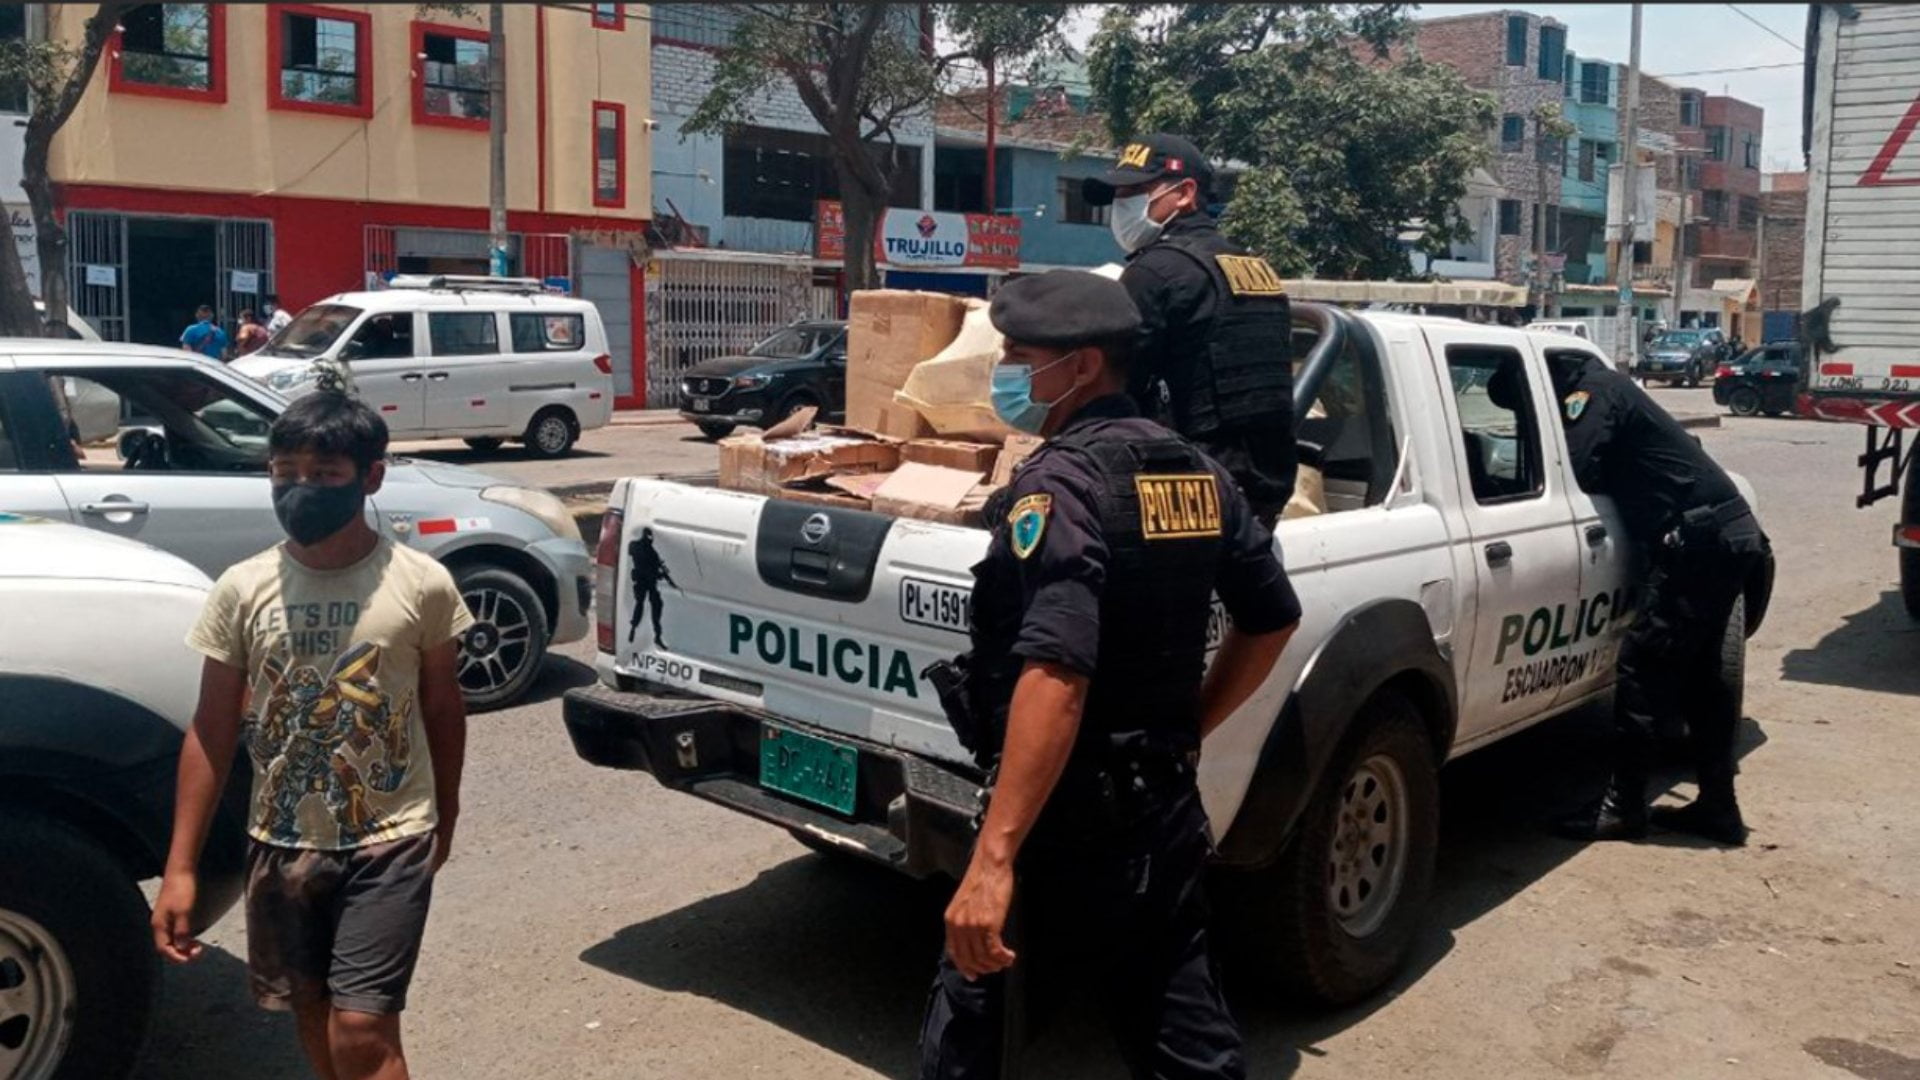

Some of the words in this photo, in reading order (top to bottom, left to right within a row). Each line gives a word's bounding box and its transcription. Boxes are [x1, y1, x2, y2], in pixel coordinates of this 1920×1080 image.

[886, 236, 965, 257] TRUJILLO
[1140, 480, 1220, 532] POLICIA
[327, 601, 360, 627] DO
[631, 652, 693, 681] NP300
[729, 613, 918, 698] POLICIA
[1502, 652, 1590, 703] ESCUADRON
